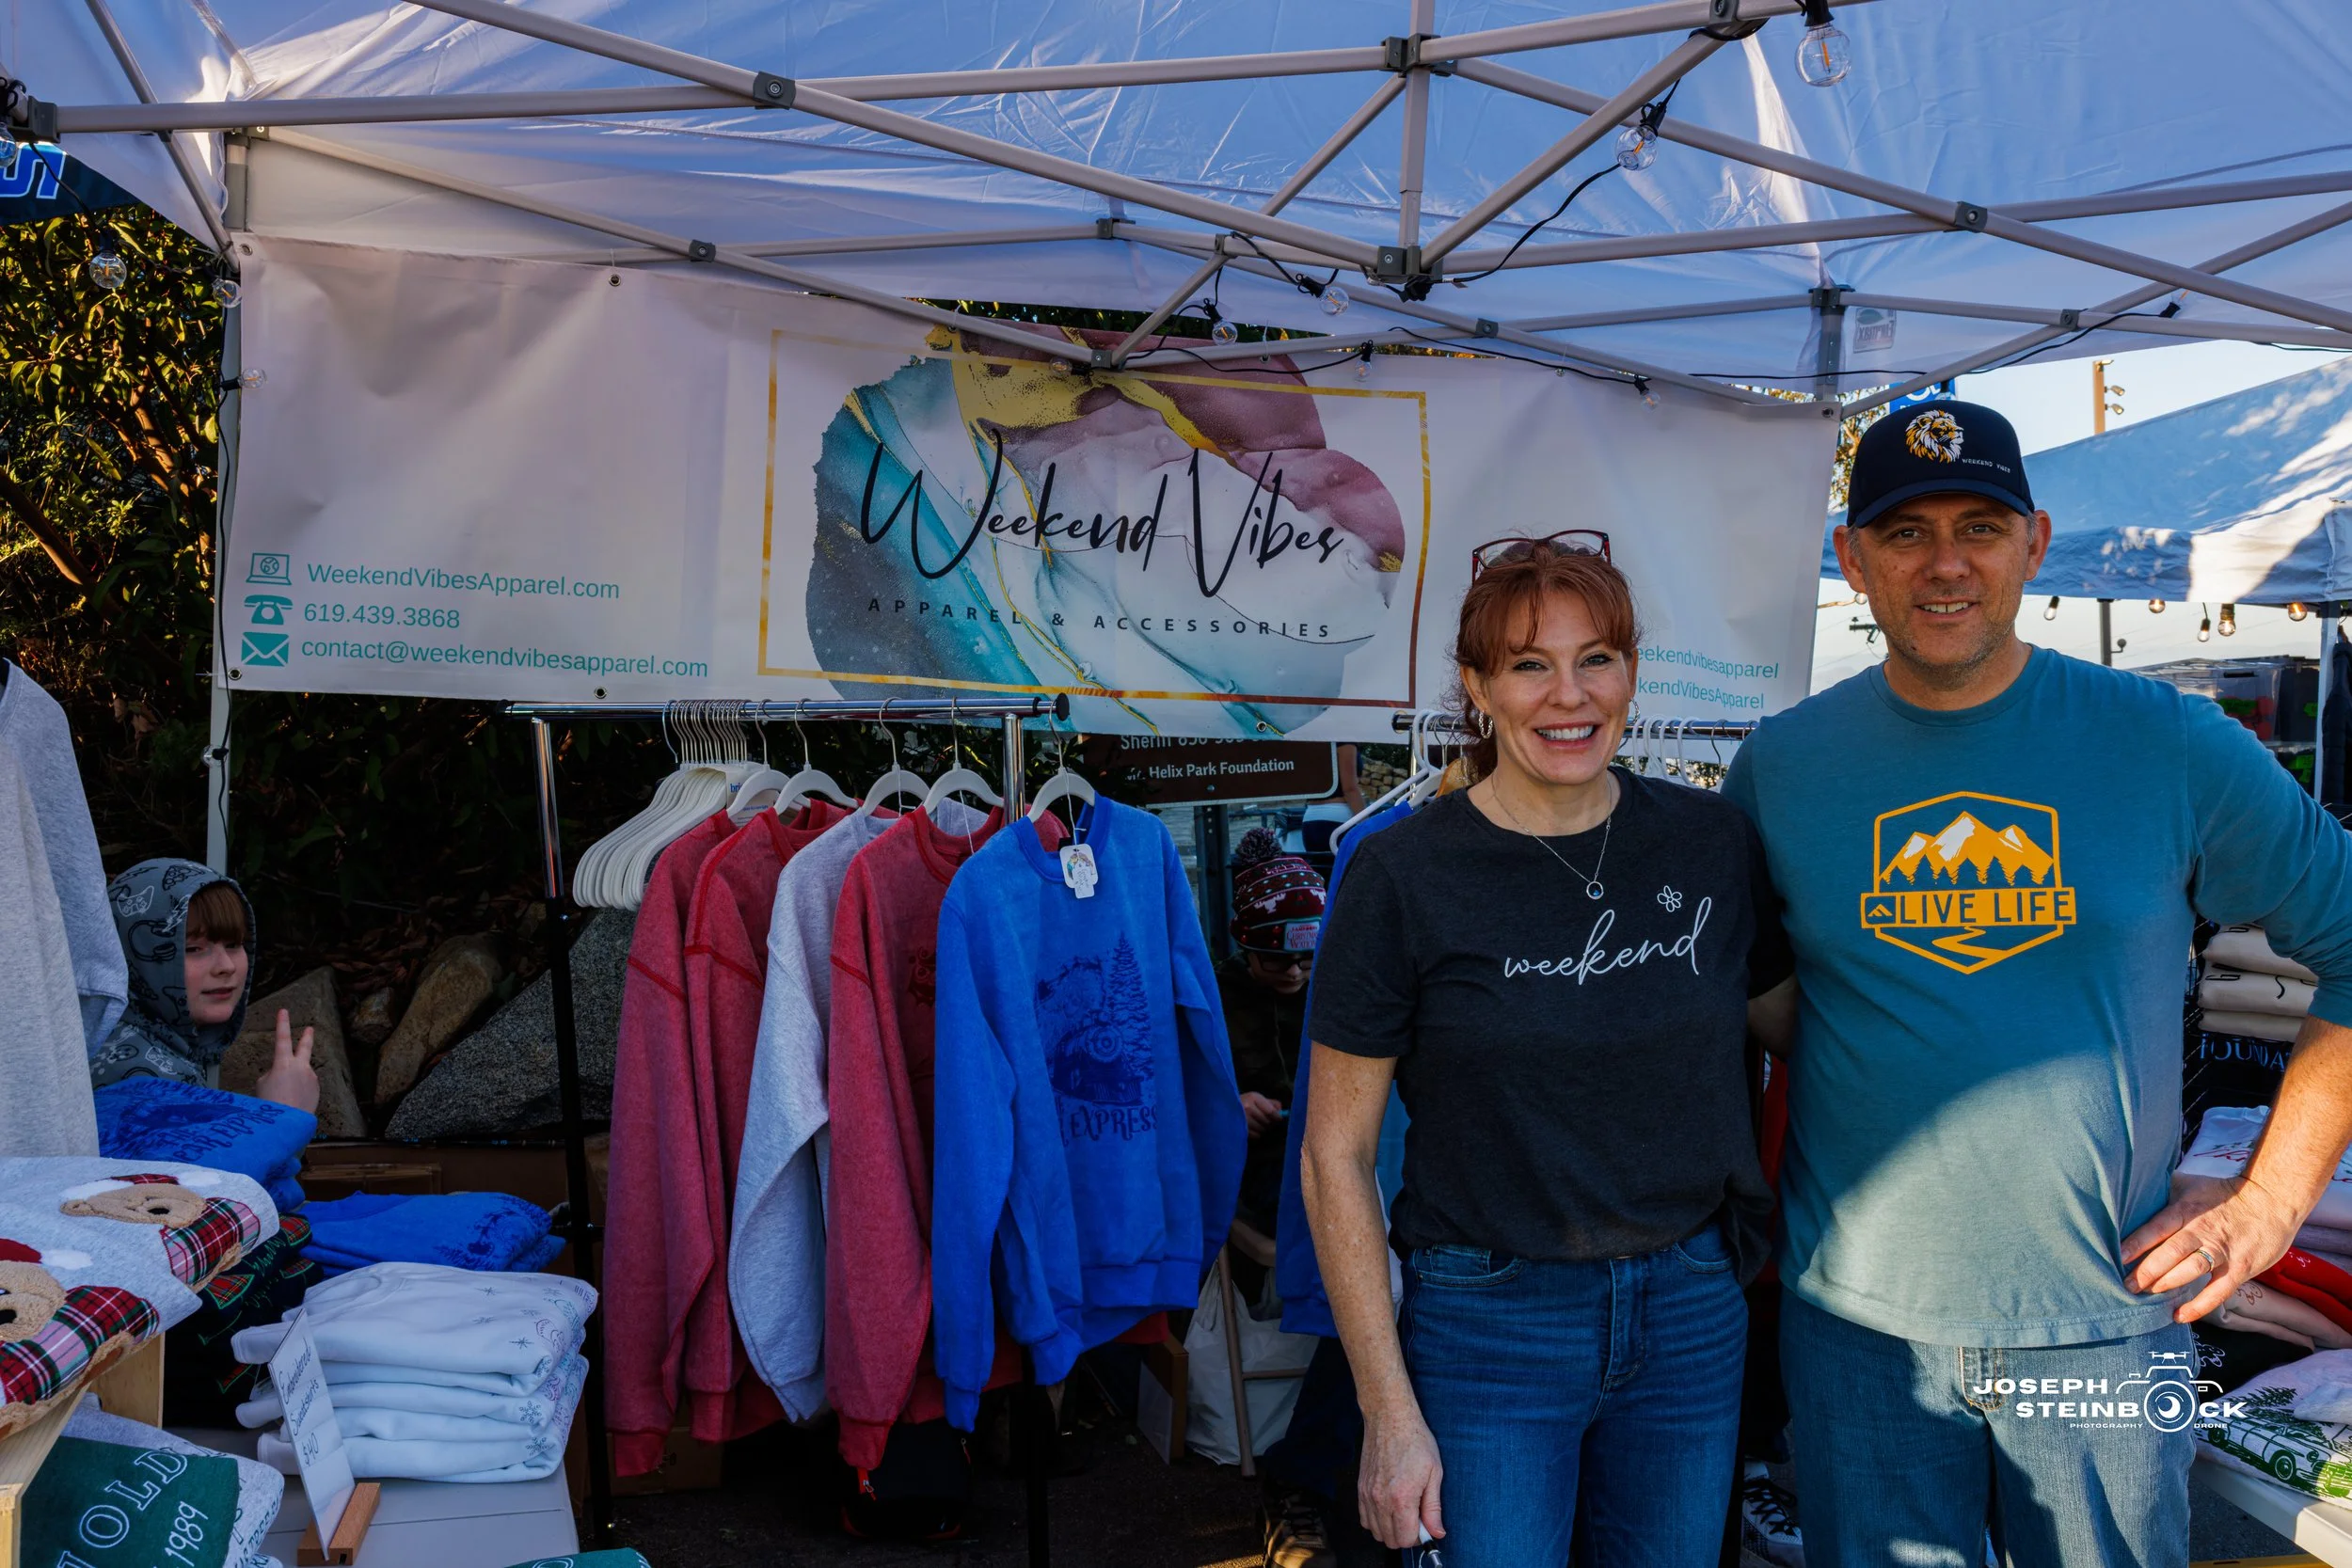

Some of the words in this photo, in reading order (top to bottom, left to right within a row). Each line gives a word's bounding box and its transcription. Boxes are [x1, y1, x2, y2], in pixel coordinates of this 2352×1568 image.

[860, 427, 1169, 579] Weekend
[1187, 447, 1344, 598] Vibes
[307, 563, 620, 599] WeekendVibesApparel.com
[303, 603, 461, 628] 619.439.3868
[867, 597, 1023, 626] APPAREL
[1051, 612, 1065, 626] &
[1092, 615, 1329, 639] ACCESSORIES
[301, 640, 708, 678] contact@weekendvibesapparel.com
[1638, 645, 1779, 680] eekendvibesapparel
[1638, 676, 1765, 711] kendVibesApparel
[1149, 764, 1184, 779] Helix
[1186, 761, 1216, 777] Park
[1219, 757, 1295, 775] Foundation
[1899, 892, 1977, 925] LIVE
[1994, 890, 2073, 924] LIFE
[1504, 896, 1712, 986] weekend
[301, 1432, 320, 1467] $40
[164, 1500, 209, 1567] 1989
